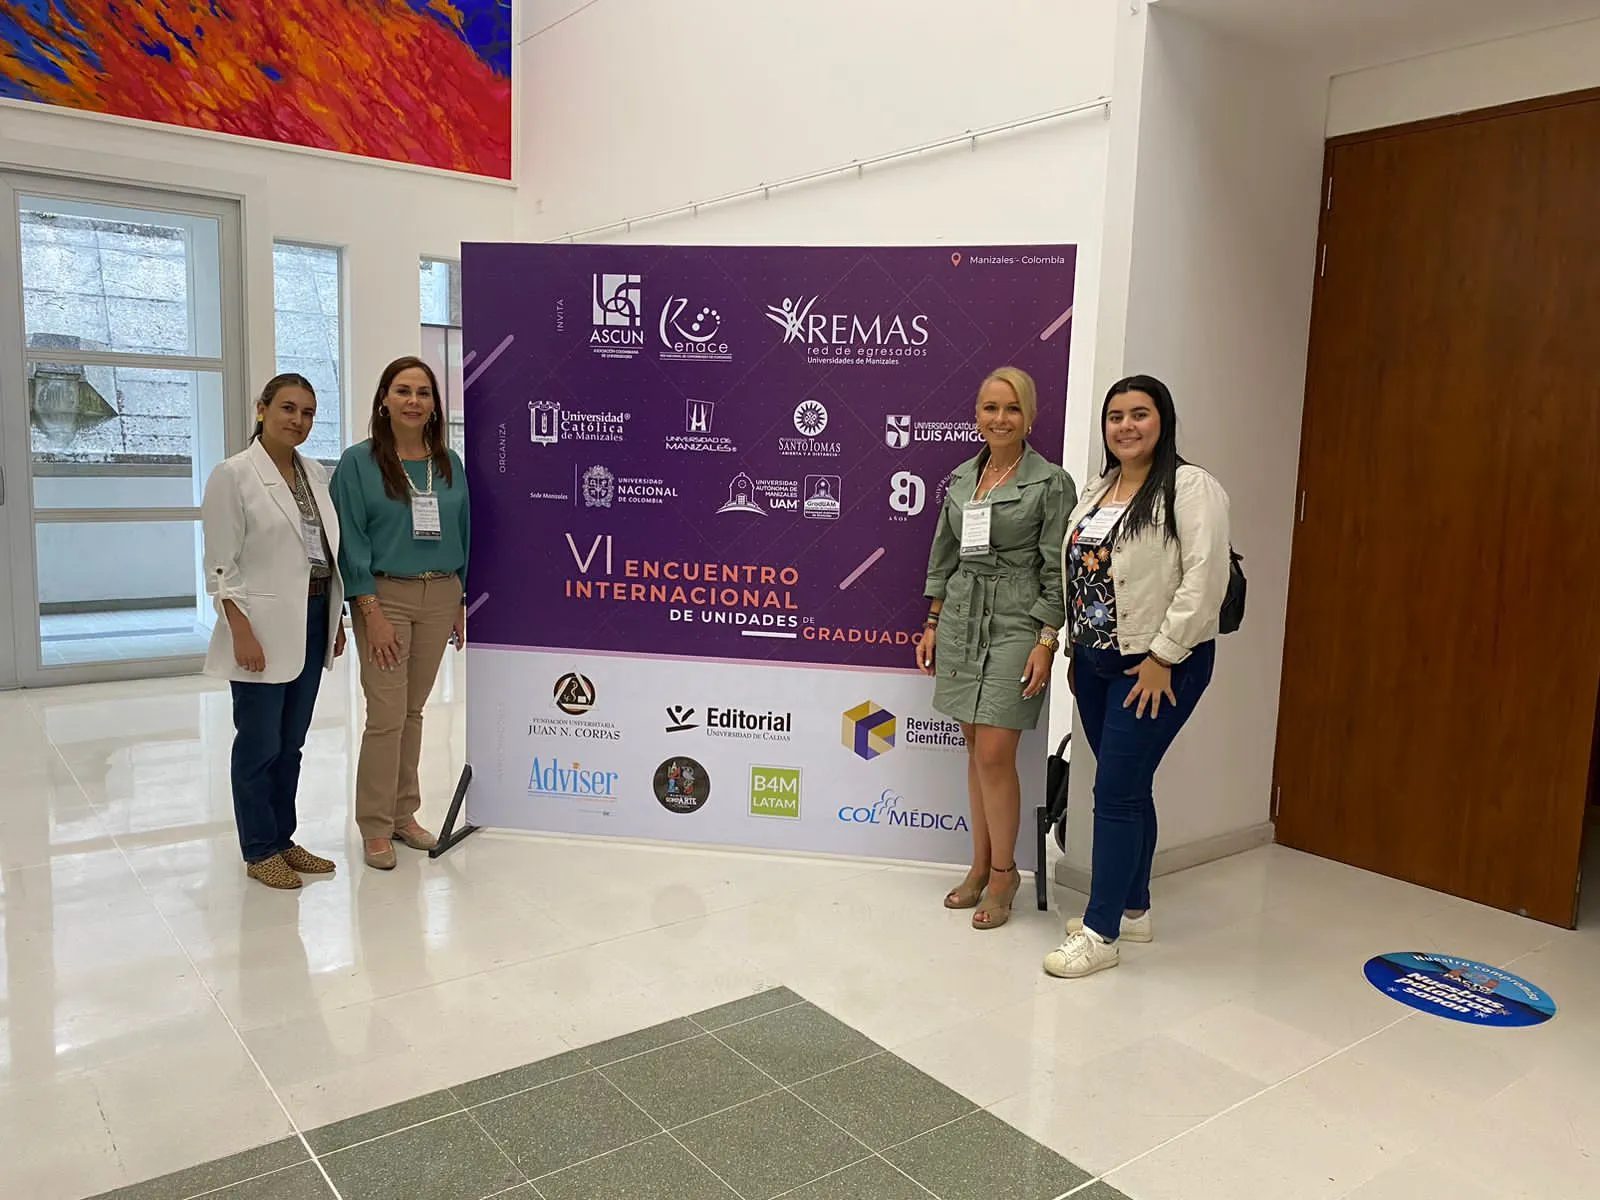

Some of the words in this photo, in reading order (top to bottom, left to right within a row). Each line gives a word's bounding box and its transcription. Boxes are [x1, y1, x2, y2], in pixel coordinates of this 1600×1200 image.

[969, 255, 1014, 264] Manizales
[1021, 255, 1065, 264] Colombia
[556, 298, 565, 332] INVITA
[807, 313, 929, 346] REMAS
[589, 329, 644, 345] ASCUN
[807, 345, 829, 356] red
[835, 346, 851, 356] de
[857, 347, 927, 359] egresados
[807, 356, 854, 365] Universidades
[855, 357, 864, 365] de
[865, 358, 899, 366] Manizales
[561, 421, 623, 434] Católica
[913, 422, 953, 430] UNIVERSIDAD
[953, 421, 977, 431] CATÓLI
[561, 431, 573, 440] de
[576, 432, 624, 442] Manizales
[665, 436, 719, 444] UNIVERSIDAD
[914, 430, 942, 442] LUIS
[778, 438, 809, 451] SANTO
[618, 477, 663, 485] UNIVERSIDAD
[618, 485, 679, 498] NACIONAL
[769, 498, 798, 509] UAM
[565, 533, 612, 575] VI
[624, 559, 799, 586] ENCUENTRO
[564, 579, 798, 610] INTERNACIONAL
[669, 609, 694, 622] DE
[701, 610, 798, 628] UNIDADES
[802, 616, 815, 624] DE
[802, 626, 923, 646] GRADUADO
[706, 707, 791, 733] Editorial
[906, 717, 960, 733] Revistas
[528, 725, 557, 736] JUAN
[560, 727, 572, 737] N.
[575, 727, 621, 740] CORPAS
[762, 732, 791, 742] CALDAS
[906, 730, 968, 747] Científica
[527, 756, 619, 796] Adviser
[754, 775, 797, 794] B4M
[753, 796, 796, 809] LATAM
[1412, 954, 1470, 967] Nuestro
[1393, 977, 1496, 1014] palabras
[1406, 972, 1505, 1009] Nuestras
[1402, 986, 1471, 1013] sanan
